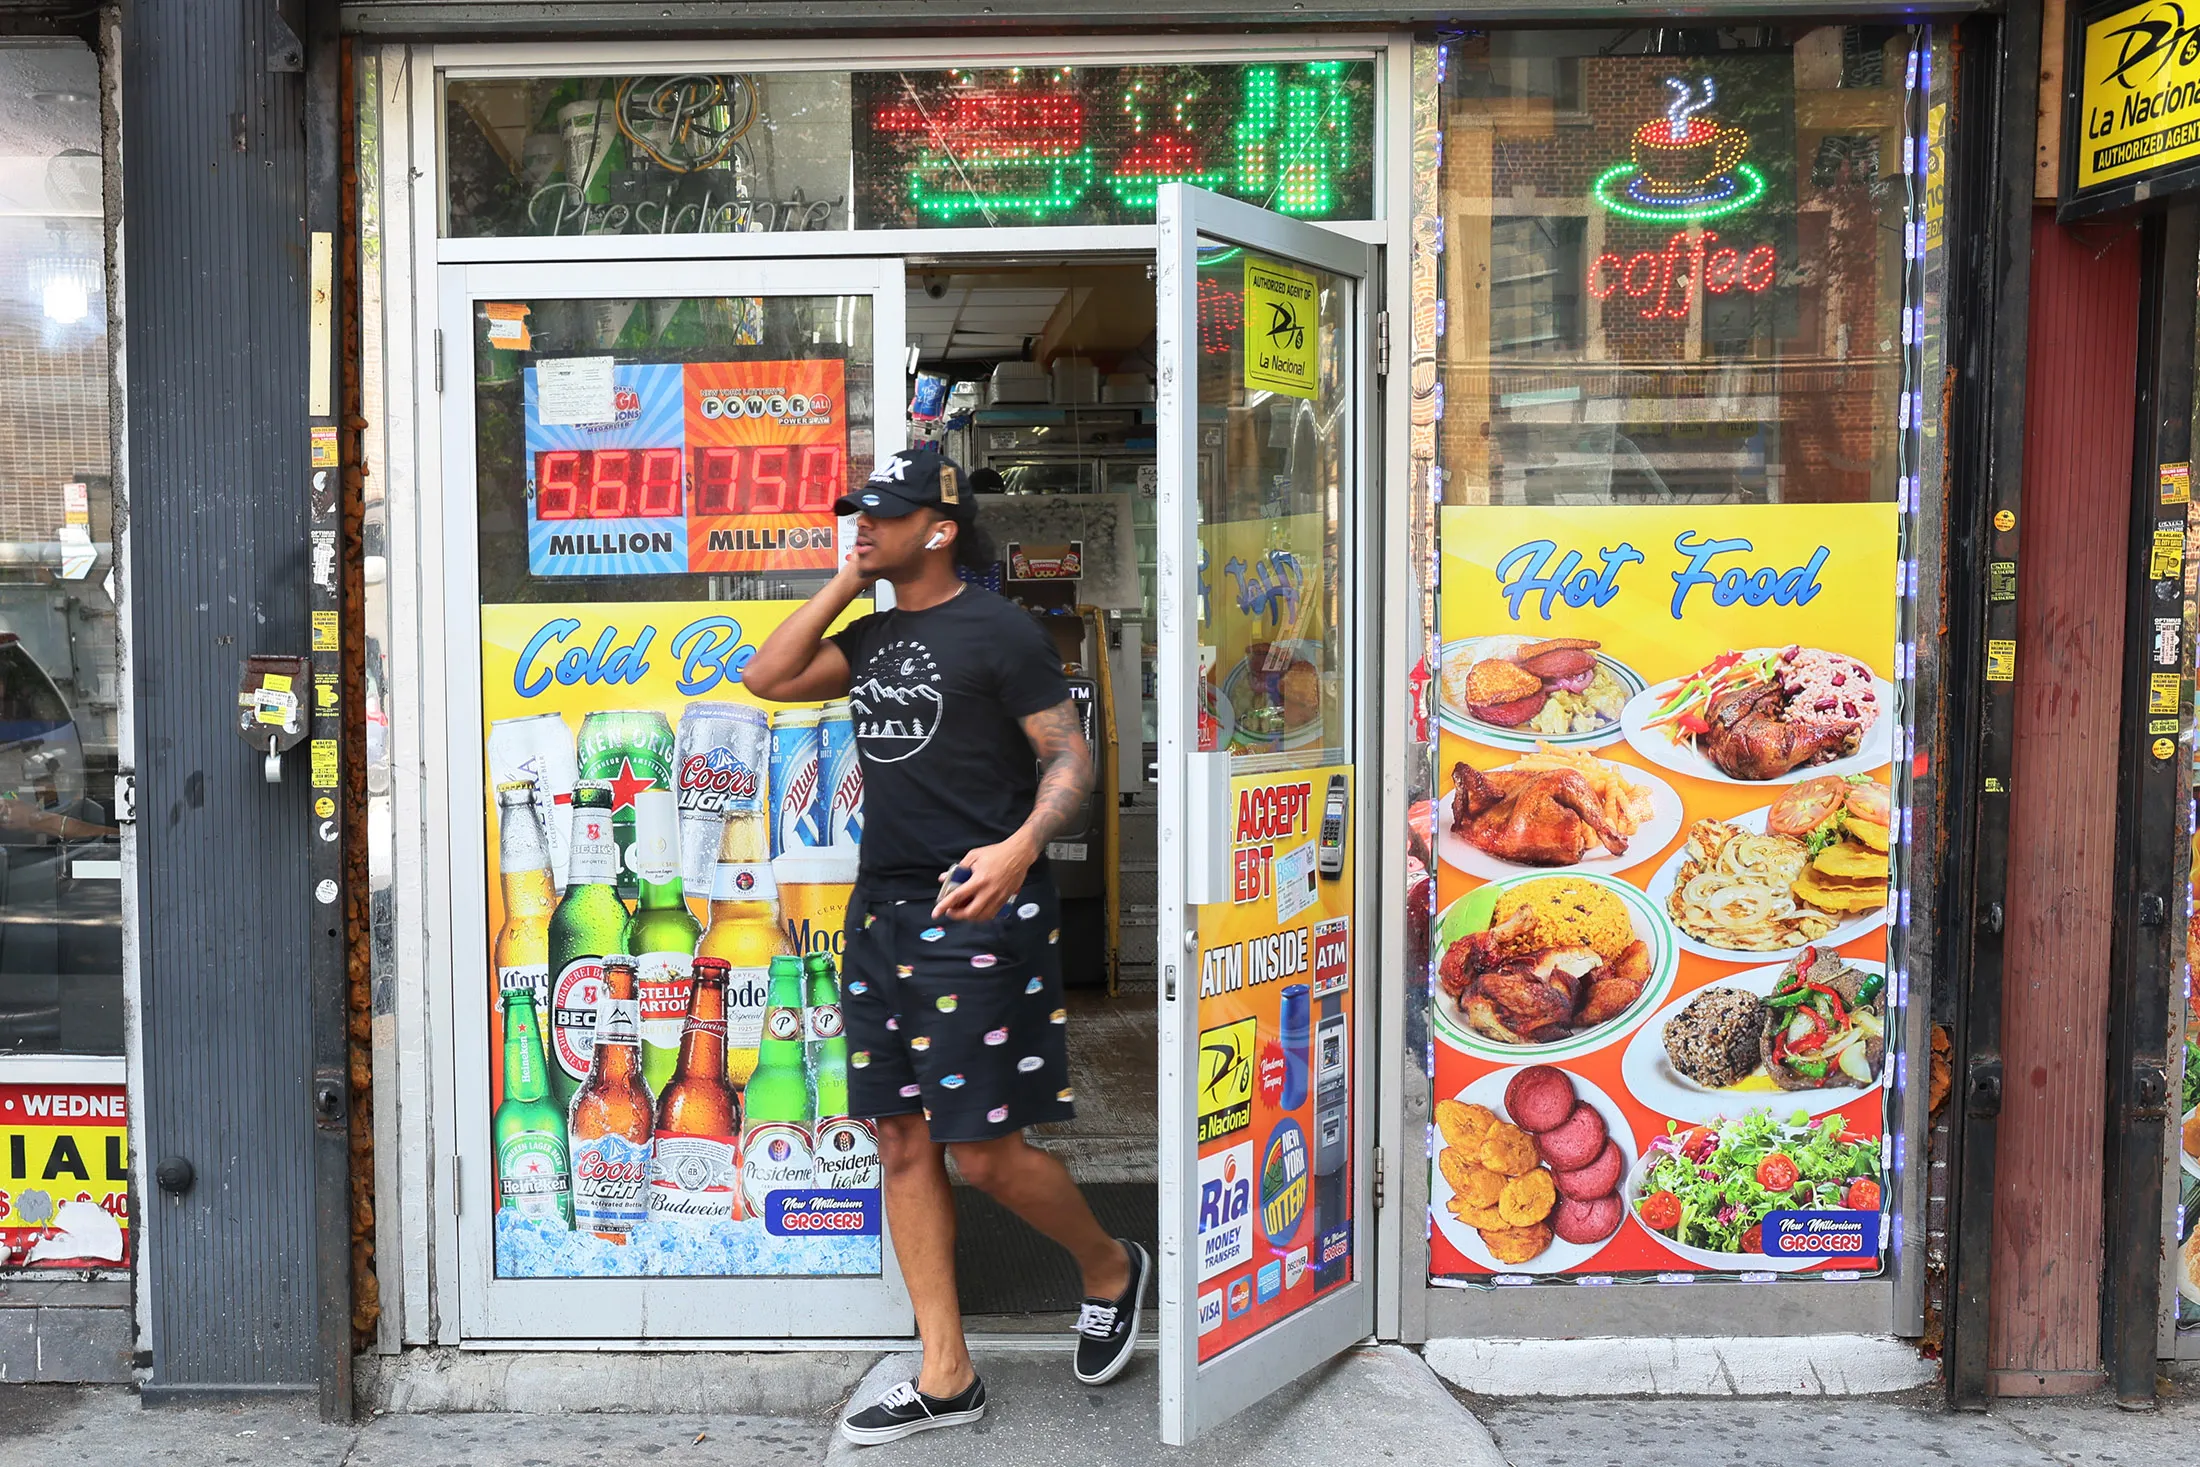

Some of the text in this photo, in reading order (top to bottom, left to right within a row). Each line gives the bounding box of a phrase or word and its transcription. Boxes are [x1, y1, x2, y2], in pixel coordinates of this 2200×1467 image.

[2089, 107, 2114, 140] La
[2098, 134, 2163, 169] AUTHORIZED
[1587, 230, 1776, 320] coffee
[1253, 276, 1311, 300] AUTHORIZED AGENT OF
[1259, 352, 1306, 376] La Nacional
[703, 396, 807, 417] POWER
[549, 532, 673, 556] MILLION
[708, 527, 832, 551] MILLION
[1495, 530, 1830, 620] Hot Food
[514, 616, 757, 698] Cold Be
[1069, 687, 1090, 699] TM
[773, 735, 779, 752] 8
[822, 728, 829, 746] 8
[679, 753, 756, 795] Coors
[782, 759, 818, 817] Mille
[1236, 782, 1311, 843] ACCEPT
[1234, 845, 1274, 904] EBT
[817, 905, 848, 916] CERV
[1200, 928, 1308, 999] ATM INSIDE
[1317, 940, 1346, 970] ATM
[557, 967, 591, 1007] BRAUEREI
[640, 986, 691, 998] STELLA
[557, 1010, 596, 1027] BEC
[521, 1035, 531, 1083] Heineken
[1208, 1102, 1250, 1138] Nacional
[1281, 1129, 1299, 1151] NEW
[579, 1150, 644, 1181] Coors
[745, 1161, 813, 1181] Presidente
[1284, 1149, 1305, 1181] YORK
[503, 1177, 567, 1194] Heineken
[577, 1180, 643, 1199] LIGHT
[651, 1191, 731, 1216] Budweiser
[782, 1197, 806, 1212] New
[1199, 1178, 1250, 1234] Ria
[1264, 1172, 1307, 1236] LOTTERY
[781, 1213, 863, 1230] GROCERY
[1779, 1217, 1862, 1233] New Millenium
[1205, 1226, 1241, 1256] MONEY
[1779, 1234, 1862, 1252] GROCERY
[1205, 1244, 1240, 1269] TRANSFER
[1199, 1301, 1220, 1324] VISA
